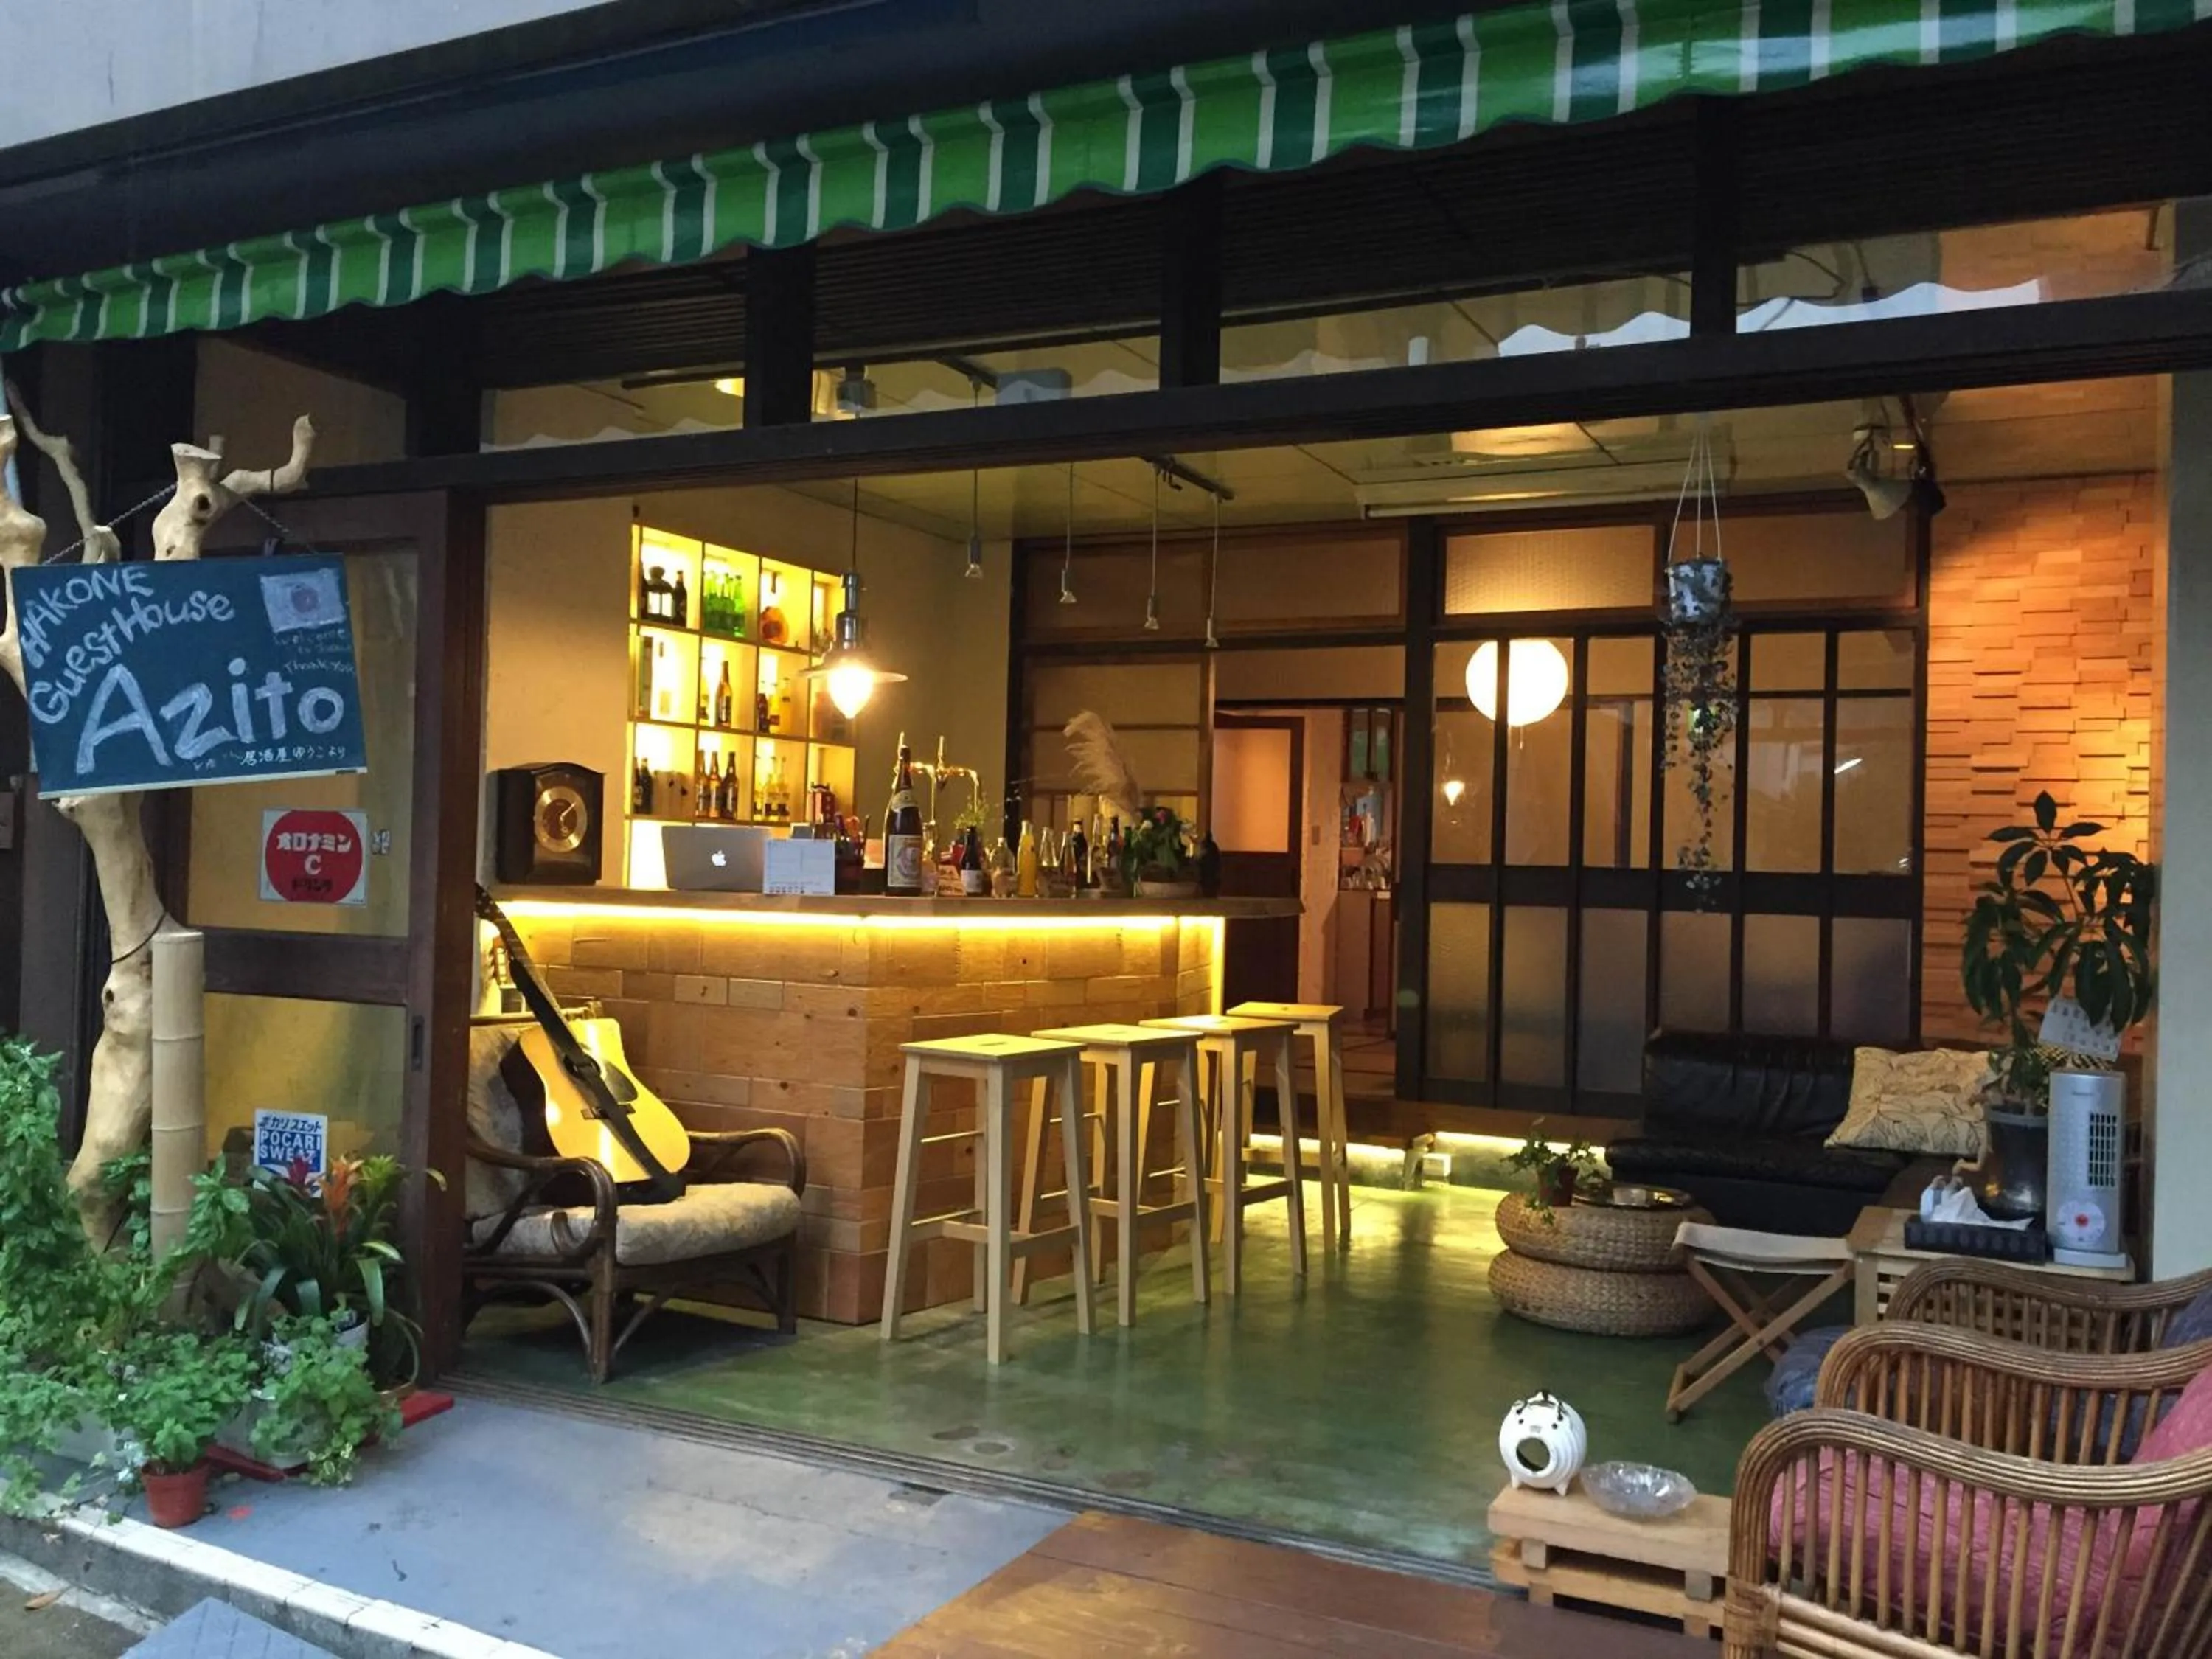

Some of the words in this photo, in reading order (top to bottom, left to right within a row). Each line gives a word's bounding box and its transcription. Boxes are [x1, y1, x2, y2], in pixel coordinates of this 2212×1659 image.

[21, 566, 154, 668] HAKONE
[304, 854, 322, 875] C
[260, 1130, 321, 1150] POCARI
